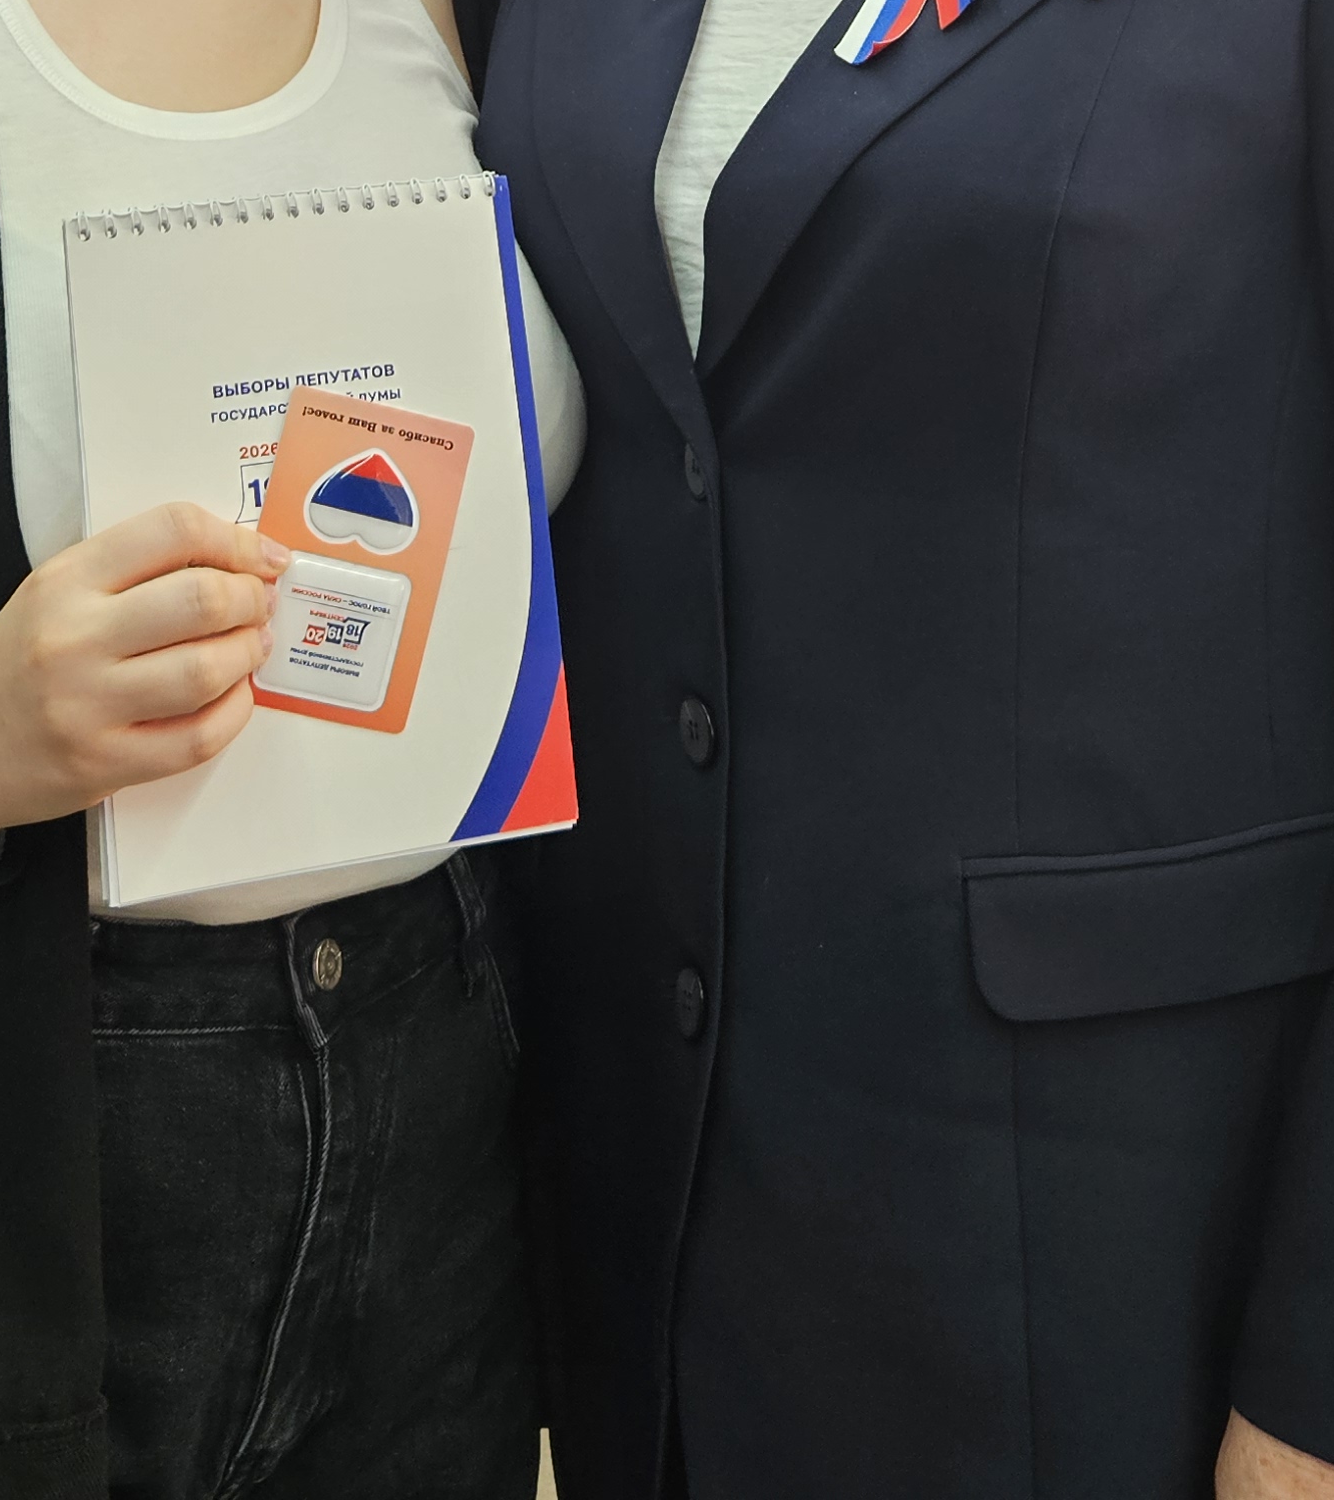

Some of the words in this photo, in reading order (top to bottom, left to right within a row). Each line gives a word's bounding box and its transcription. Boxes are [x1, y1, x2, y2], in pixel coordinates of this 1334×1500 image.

[212, 377, 290, 399] ВЫБОРЫ
[295, 364, 395, 387] ДЕПУТАТОВ
[302, 406, 345, 423] голос!
[347, 416, 378, 433] Ваш
[381, 424, 396, 435] за
[398, 428, 454, 451] Спасибо
[239, 442, 278, 460] 2026
[323, 594, 342, 604] СИЛА
[348, 600, 372, 610] ГОЛОС
[372, 605, 390, 614] ТВОЙ
[306, 627, 325, 642] 20
[328, 627, 341, 640] 19
[346, 624, 360, 637] 18
[289, 657, 330, 671] ДЕПУТАТОВ
[330, 666, 360, 677] ВЫБОРЫ
